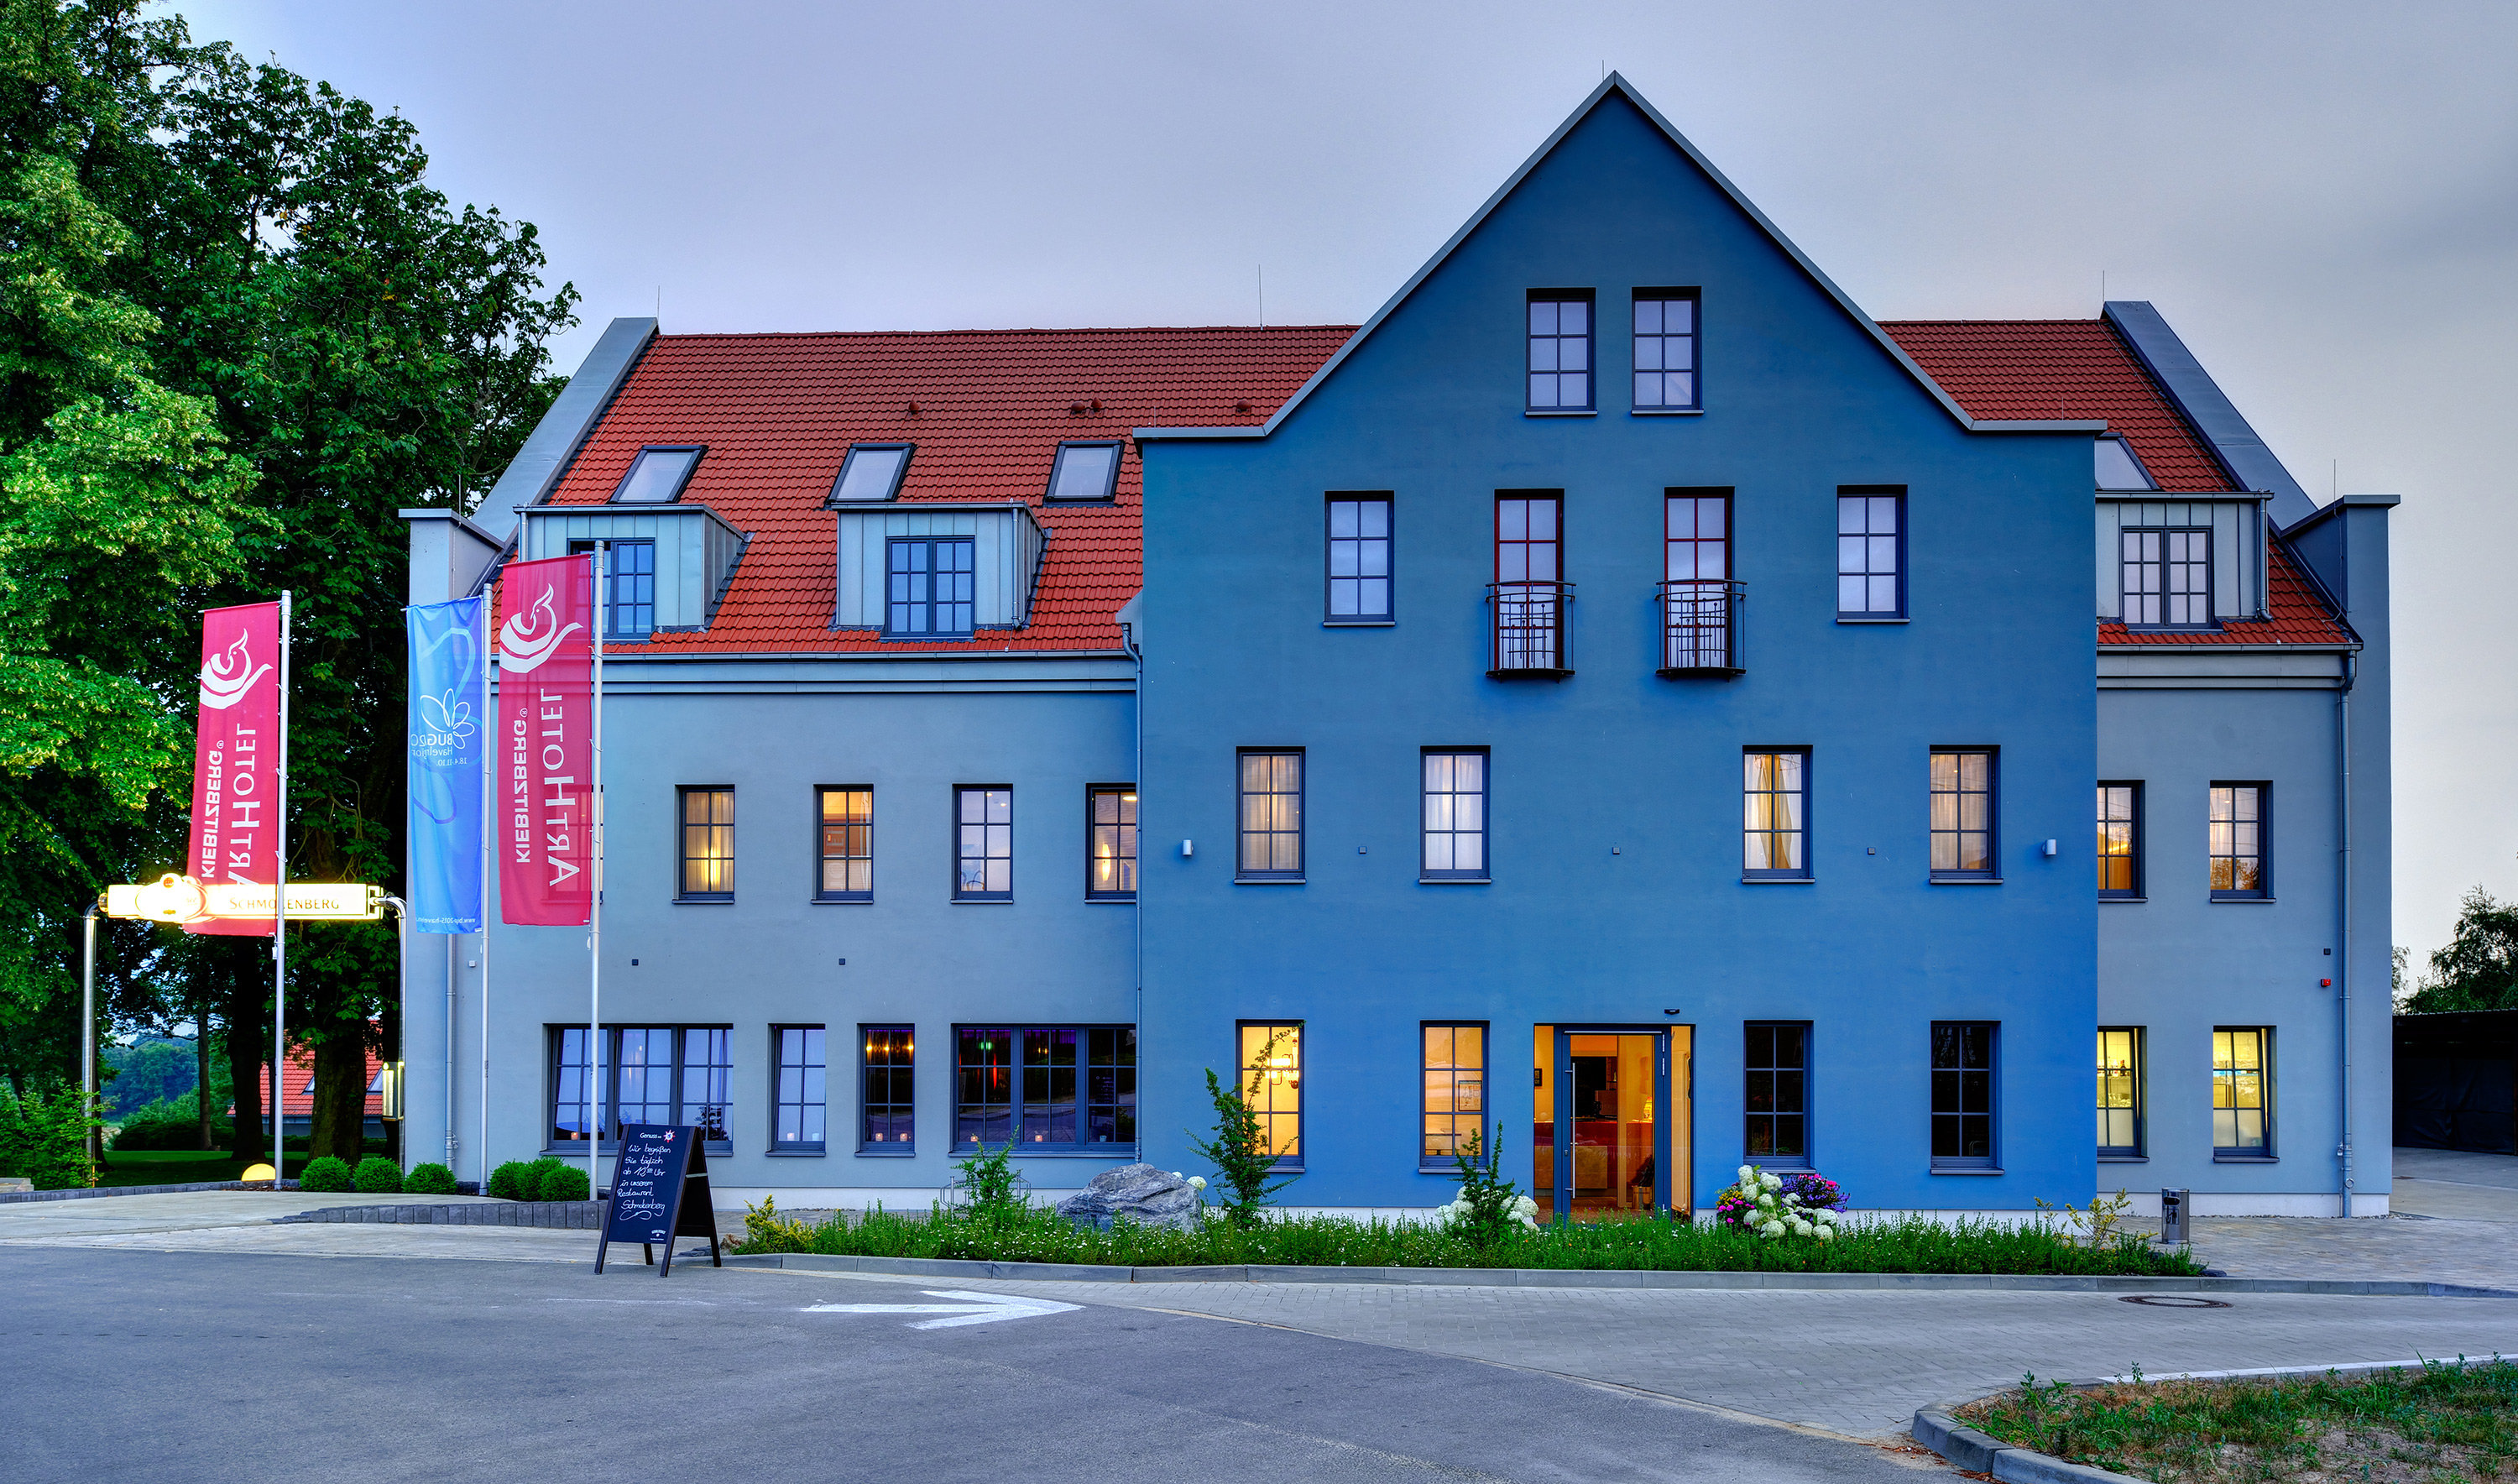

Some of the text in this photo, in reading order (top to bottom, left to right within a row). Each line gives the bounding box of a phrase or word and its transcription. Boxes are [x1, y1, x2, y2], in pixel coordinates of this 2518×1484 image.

[229, 897, 339, 910] SCHMOENBERG
[640, 1155, 663, 1168] täglich
[653, 1168, 666, 1177] Uhr
[617, 1187, 654, 1197] Restaurant
[621, 1199, 665, 1216] Schmokenberg
